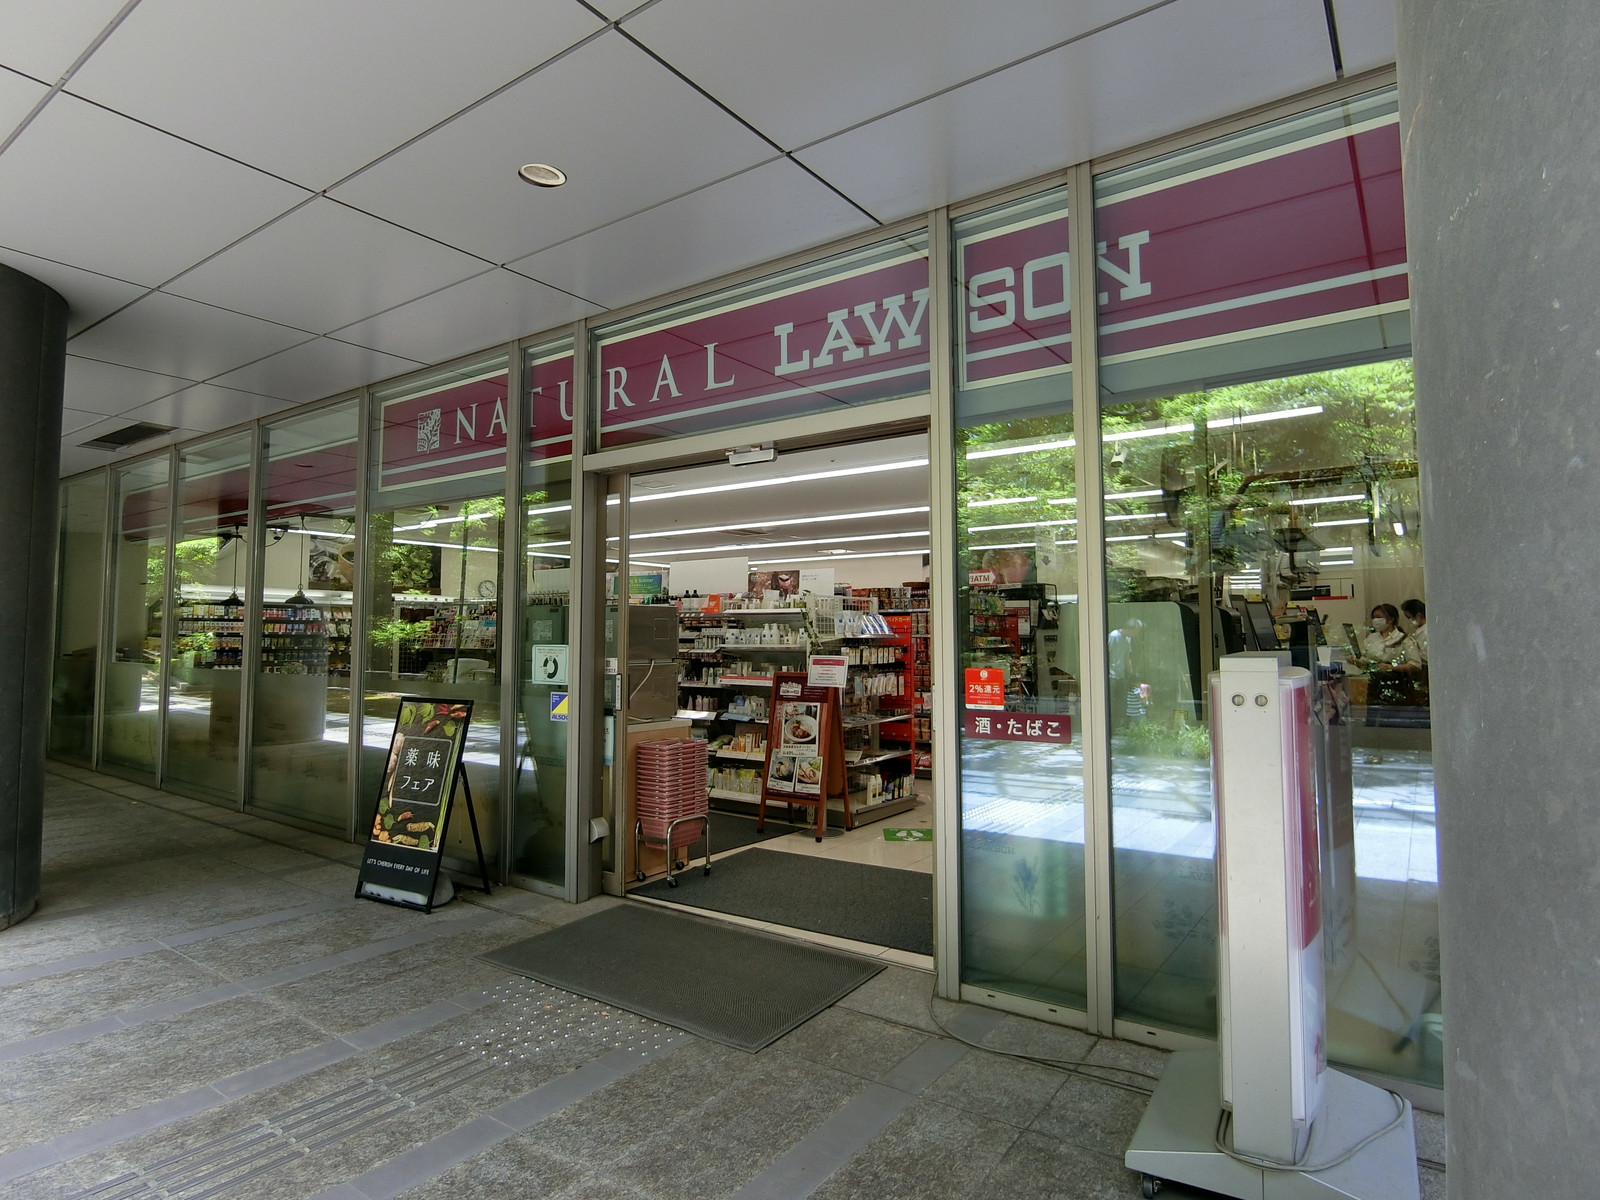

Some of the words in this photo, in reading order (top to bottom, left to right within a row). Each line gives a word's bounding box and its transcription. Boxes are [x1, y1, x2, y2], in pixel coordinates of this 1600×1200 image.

[454, 342, 735, 444] NATURAL
[774, 229, 1152, 376] LAWSON
[969, 684, 1000, 694] 2%還元
[975, 716, 1061, 737] 酒・たばこ
[400, 775, 435, 792] フェア
[420, 868, 430, 876] LIFE
